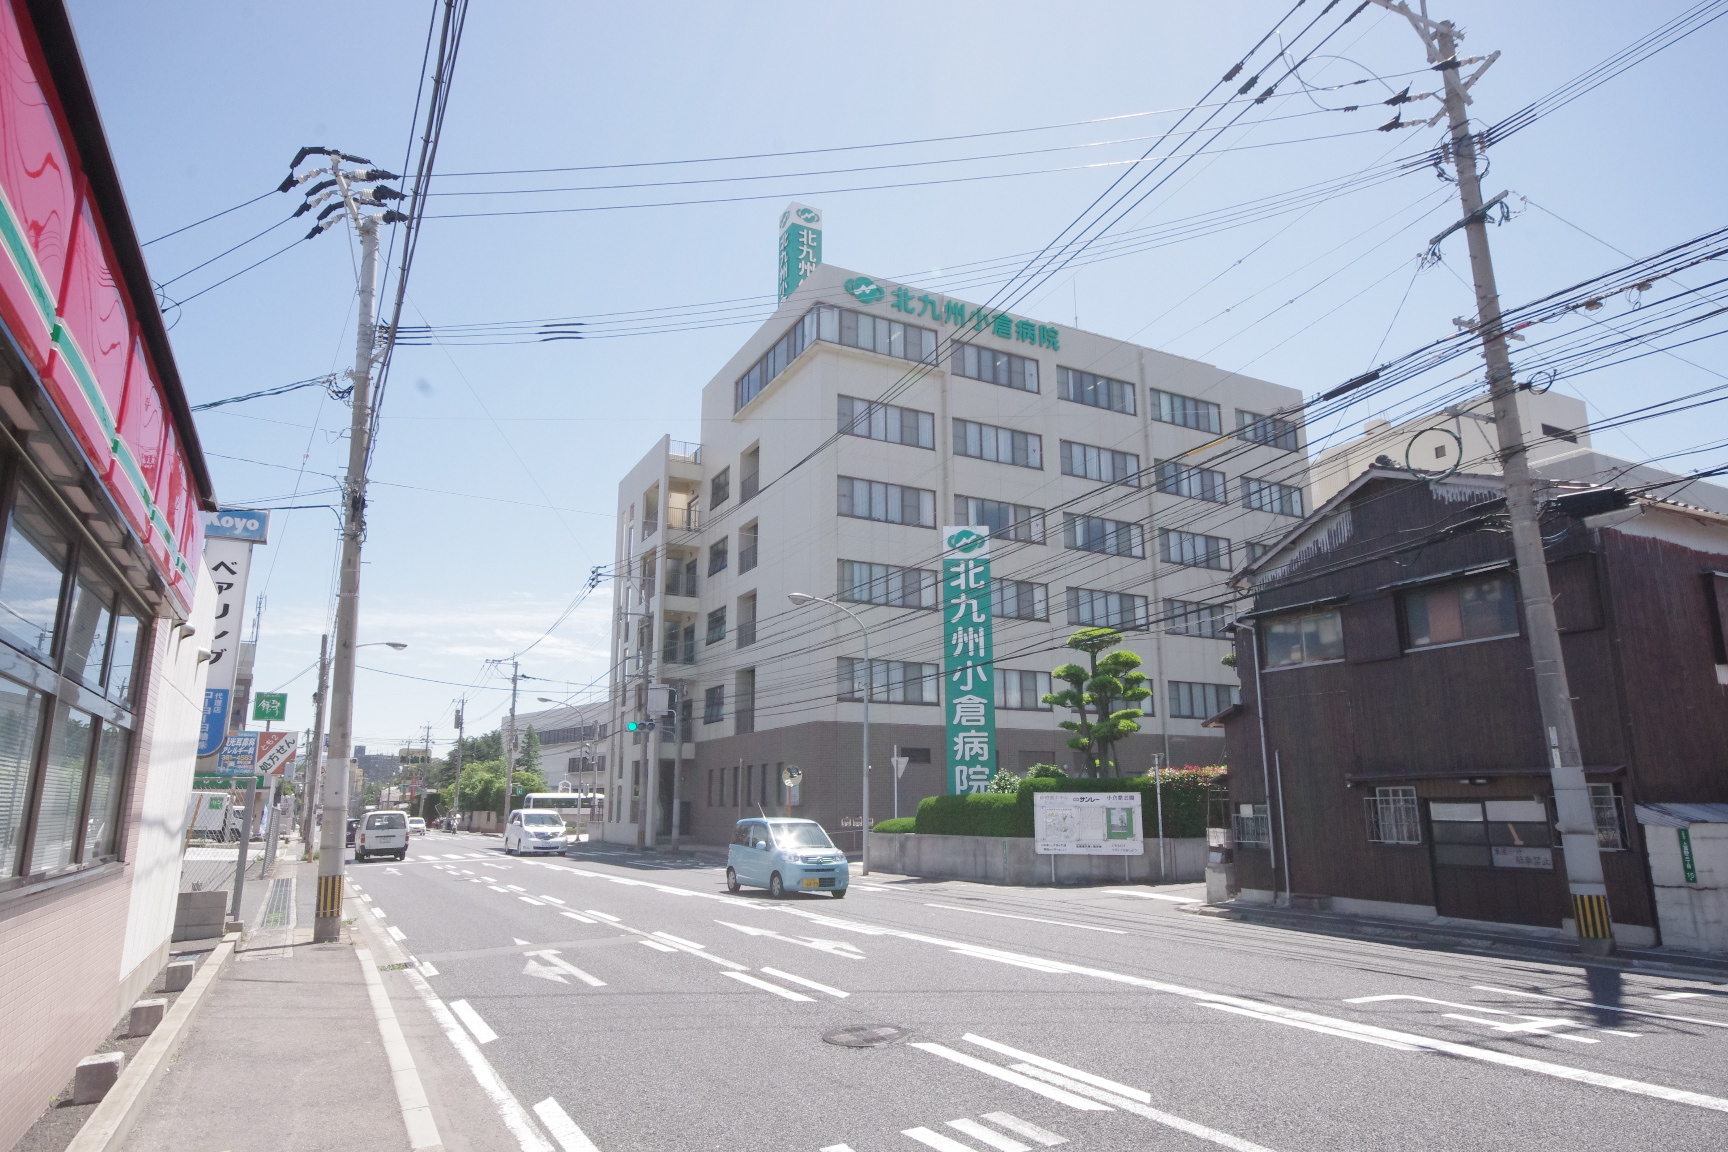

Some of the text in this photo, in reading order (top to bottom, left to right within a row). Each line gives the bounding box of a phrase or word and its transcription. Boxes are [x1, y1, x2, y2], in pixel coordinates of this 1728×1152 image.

[890, 286, 1061, 351] 北九州小倉病院
[206, 511, 260, 535] Koyo
[949, 559, 990, 795] 北九州小倉病院
[259, 738, 296, 773] 処方せん
